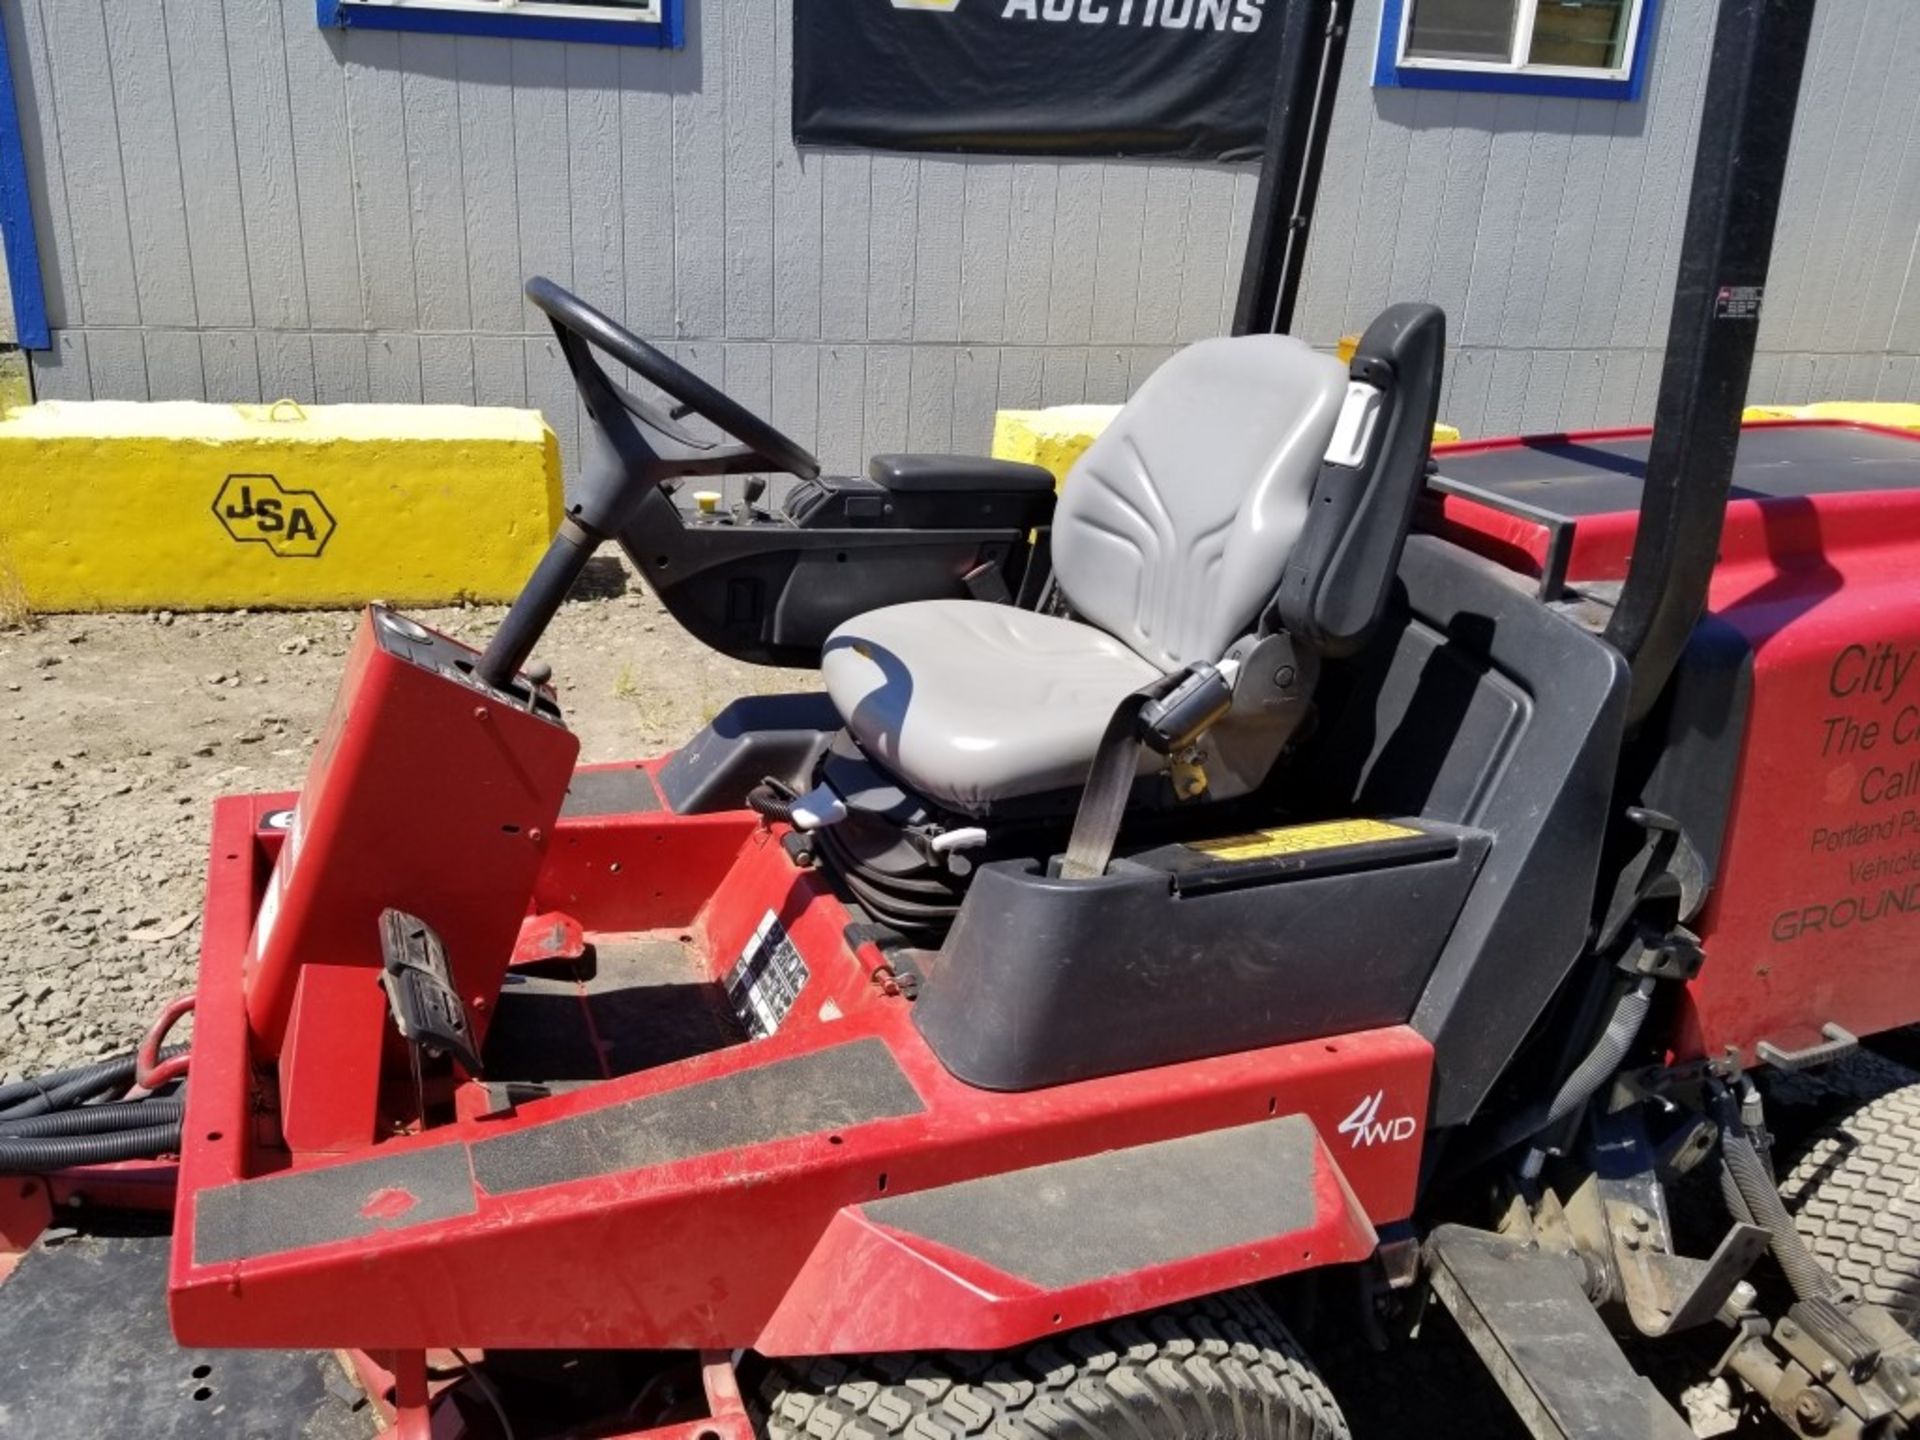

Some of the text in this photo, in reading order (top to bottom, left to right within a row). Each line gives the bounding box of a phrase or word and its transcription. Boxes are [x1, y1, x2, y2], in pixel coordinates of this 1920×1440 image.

[1001, 0, 1264, 33] AUCTIONS
[226, 485, 317, 541] JSA
[1829, 641, 1917, 704] City
[1822, 715, 1880, 758] The
[1810, 815, 1895, 854] Portland
[1337, 1089, 1417, 1149] 4WD
